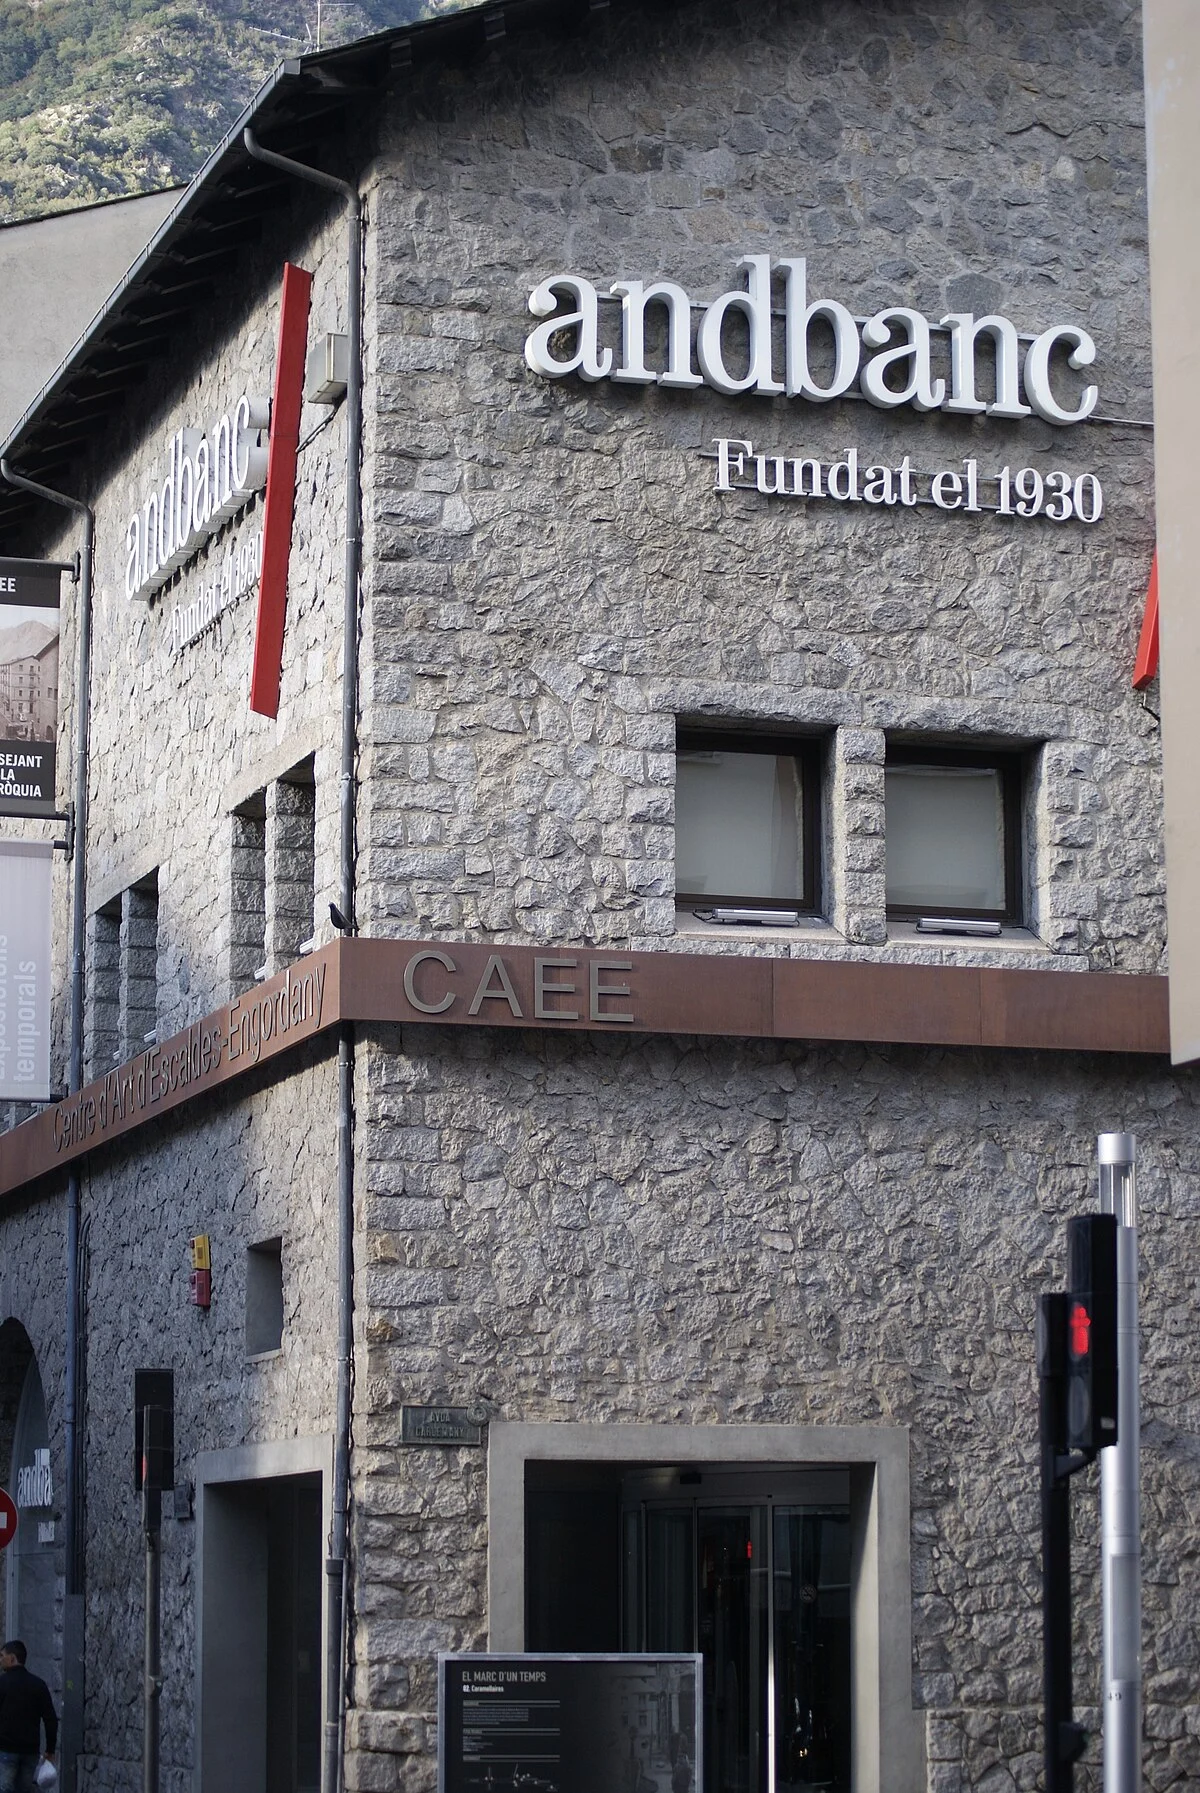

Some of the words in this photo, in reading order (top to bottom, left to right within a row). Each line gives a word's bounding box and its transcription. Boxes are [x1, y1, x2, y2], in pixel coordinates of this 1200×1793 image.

[523, 253, 1099, 427] andbanc
[125, 394, 255, 601] andbanc
[711, 438, 917, 507] Fundat
[931, 459, 982, 513] el
[995, 466, 1103, 524] 1930
[170, 572, 219, 658] Fundat
[234, 530, 264, 599] 1930
[0, 768, 16, 781] LA
[13, 960, 41, 1082] temporals
[403, 949, 635, 1023] CAEE
[52, 1091, 96, 1153] Centre
[100, 1067, 135, 1131] d'Art
[136, 962, 327, 1104] d'Escaldes-Engordany
[462, 1671, 472, 1682] EL
[473, 1671, 497, 1682] MARC
[498, 1671, 518, 1682] D'UN
[519, 1671, 547, 1682] TEMPS
